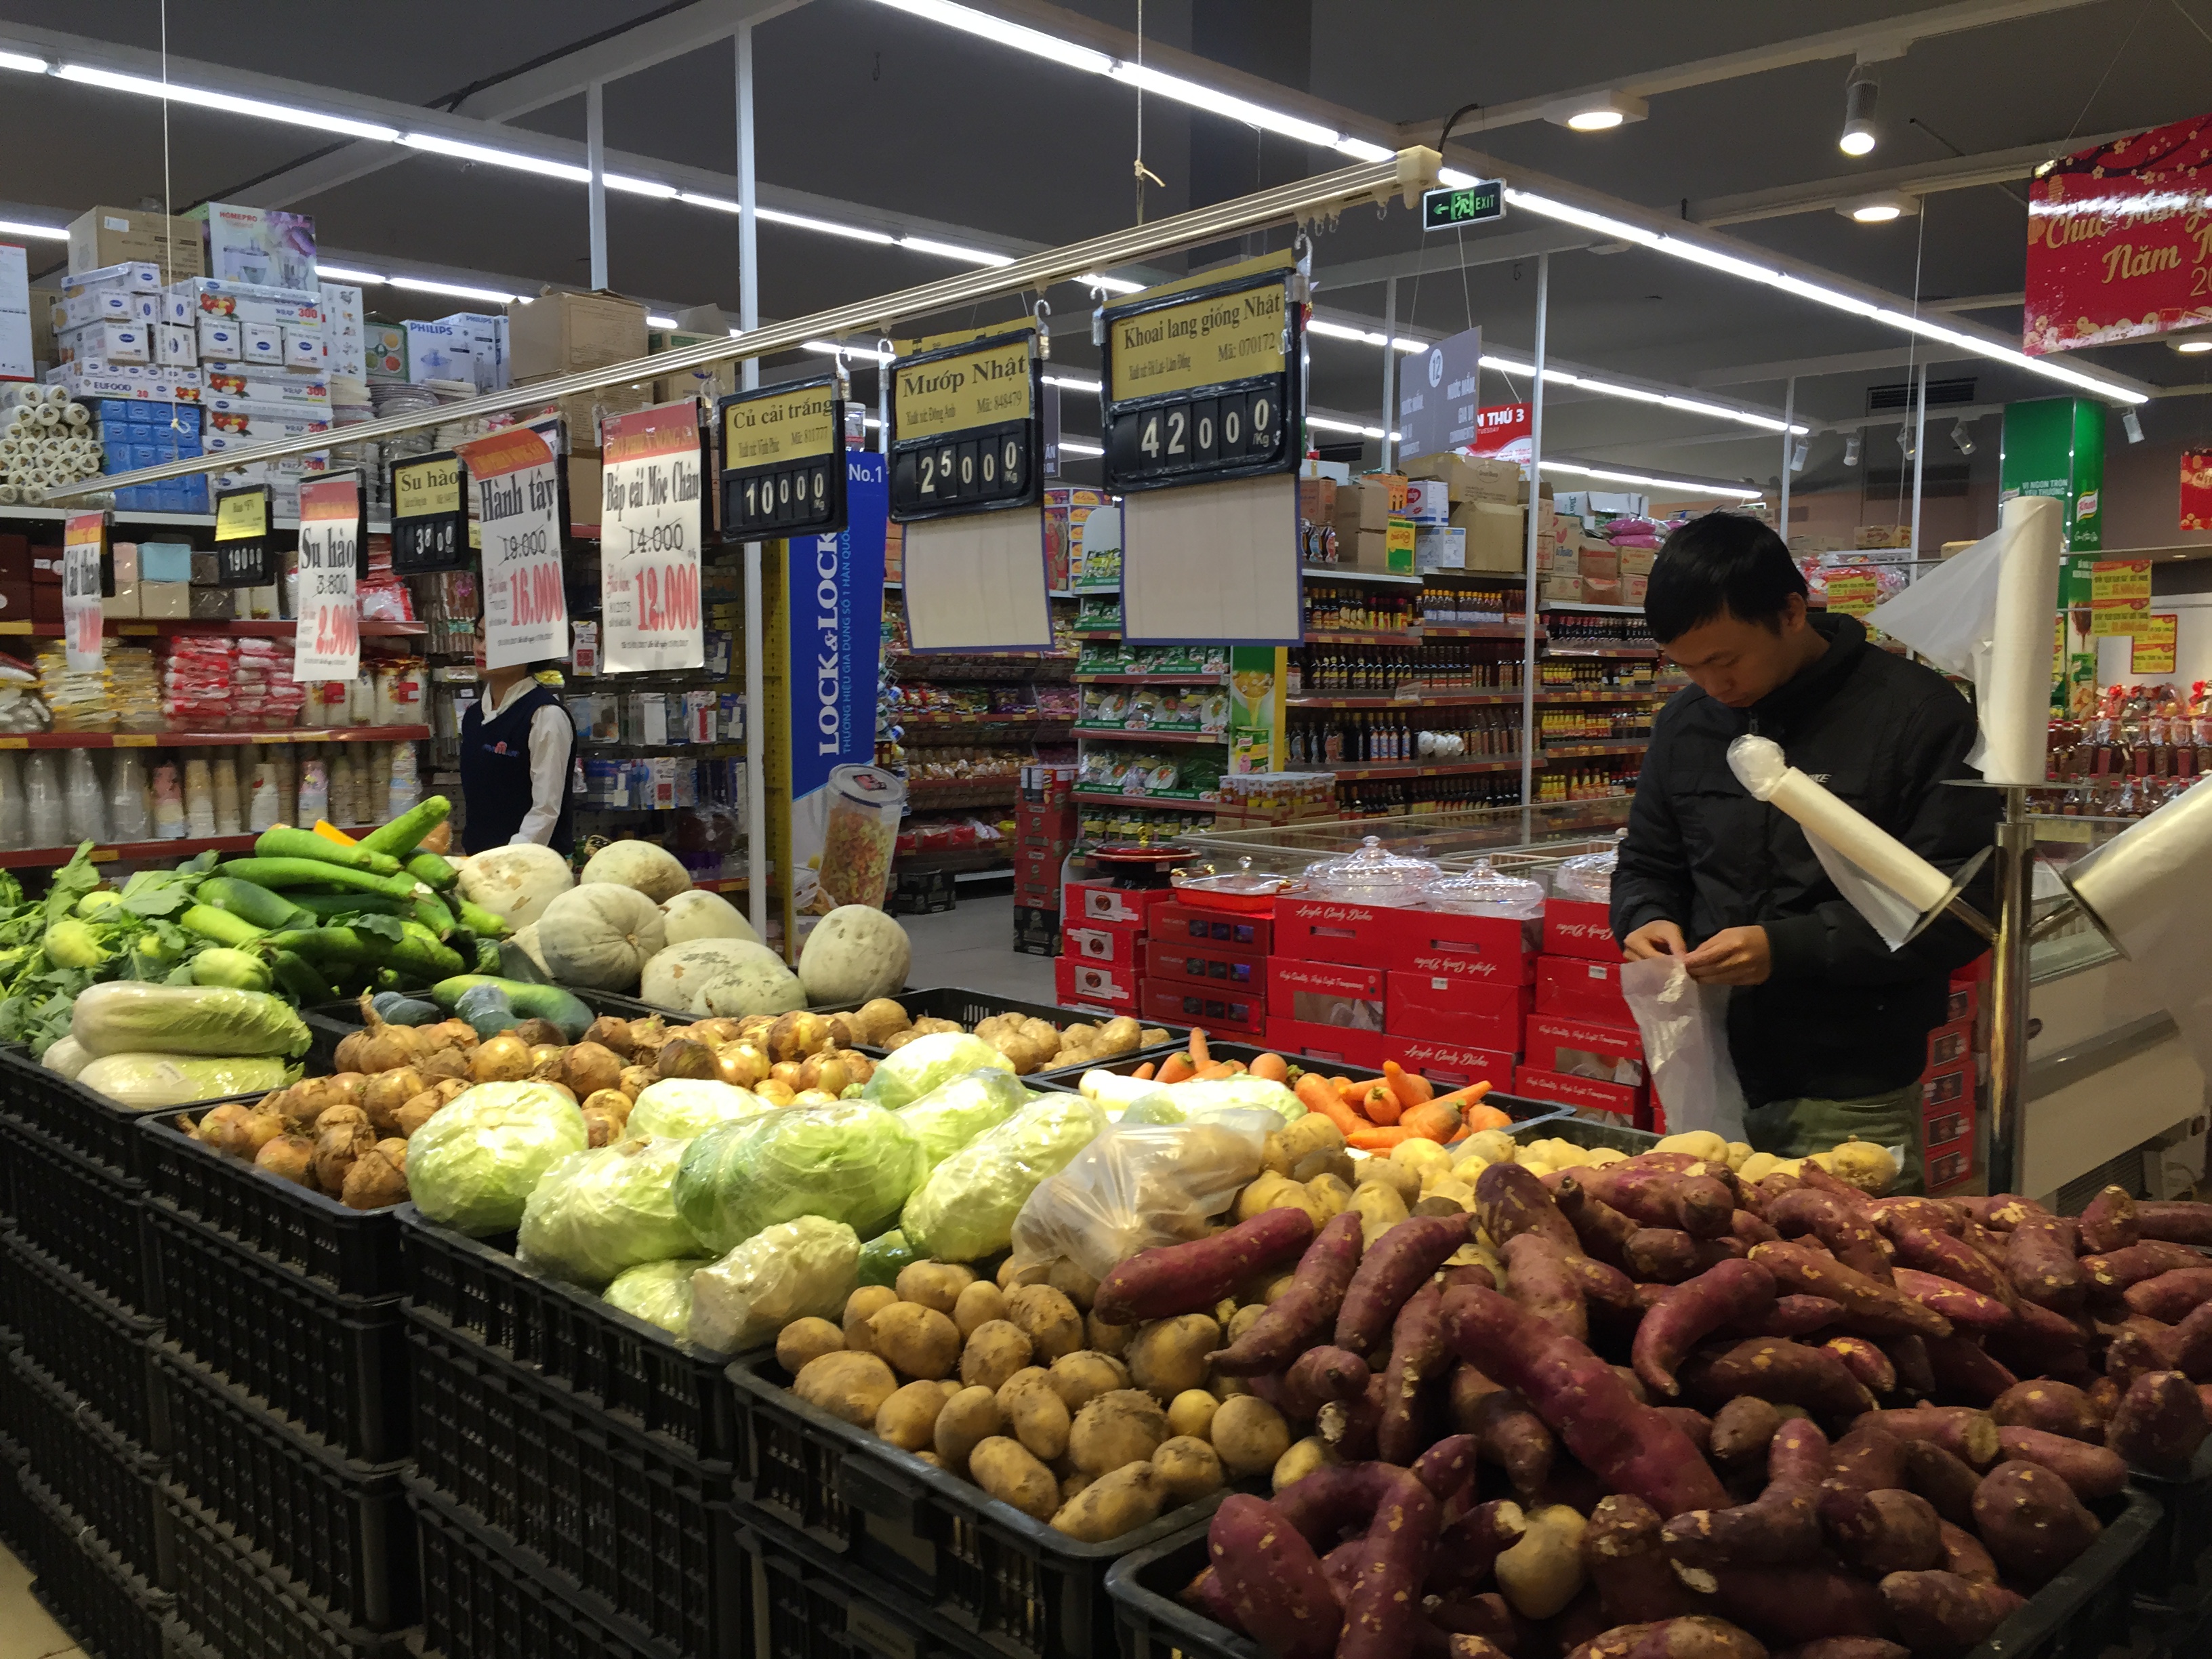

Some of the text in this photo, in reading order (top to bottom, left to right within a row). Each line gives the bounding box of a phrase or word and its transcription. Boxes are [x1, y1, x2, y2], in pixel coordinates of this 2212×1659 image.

[1475, 194, 1495, 210] EXIT
[220, 211, 258, 222] HOMEPRO
[2102, 244, 2182, 284] Năm
[298, 308, 318, 319] 300
[466, 315, 493, 324] PHILIPS
[1124, 293, 1280, 350] Khoai lang giống Nhật
[410, 322, 453, 335] PHILIPS
[1218, 332, 1275, 362] Mã: 070172
[903, 354, 1027, 398] Mướp Nhật
[1432, 354, 1441, 381] 12
[94, 382, 131, 392] EUFOOD
[136, 390, 148, 398] 30
[306, 386, 327, 396] 300
[733, 398, 833, 429] Củ cải trắng
[1487, 407, 1513, 426] THỨ
[1516, 409, 1524, 422] 3
[401, 469, 459, 492] Su hào
[848, 463, 882, 483] No.1
[478, 468, 554, 523] Hành tây
[300, 527, 321, 569] Su
[629, 523, 684, 554] 14.000
[840, 565, 851, 588] HÀN
[510, 561, 563, 627] 16.000
[636, 563, 699, 631] 12.000
[842, 617, 853, 651] DỤNG
[842, 653, 851, 672] GIA
[842, 705, 852, 754] THƯƠNG
